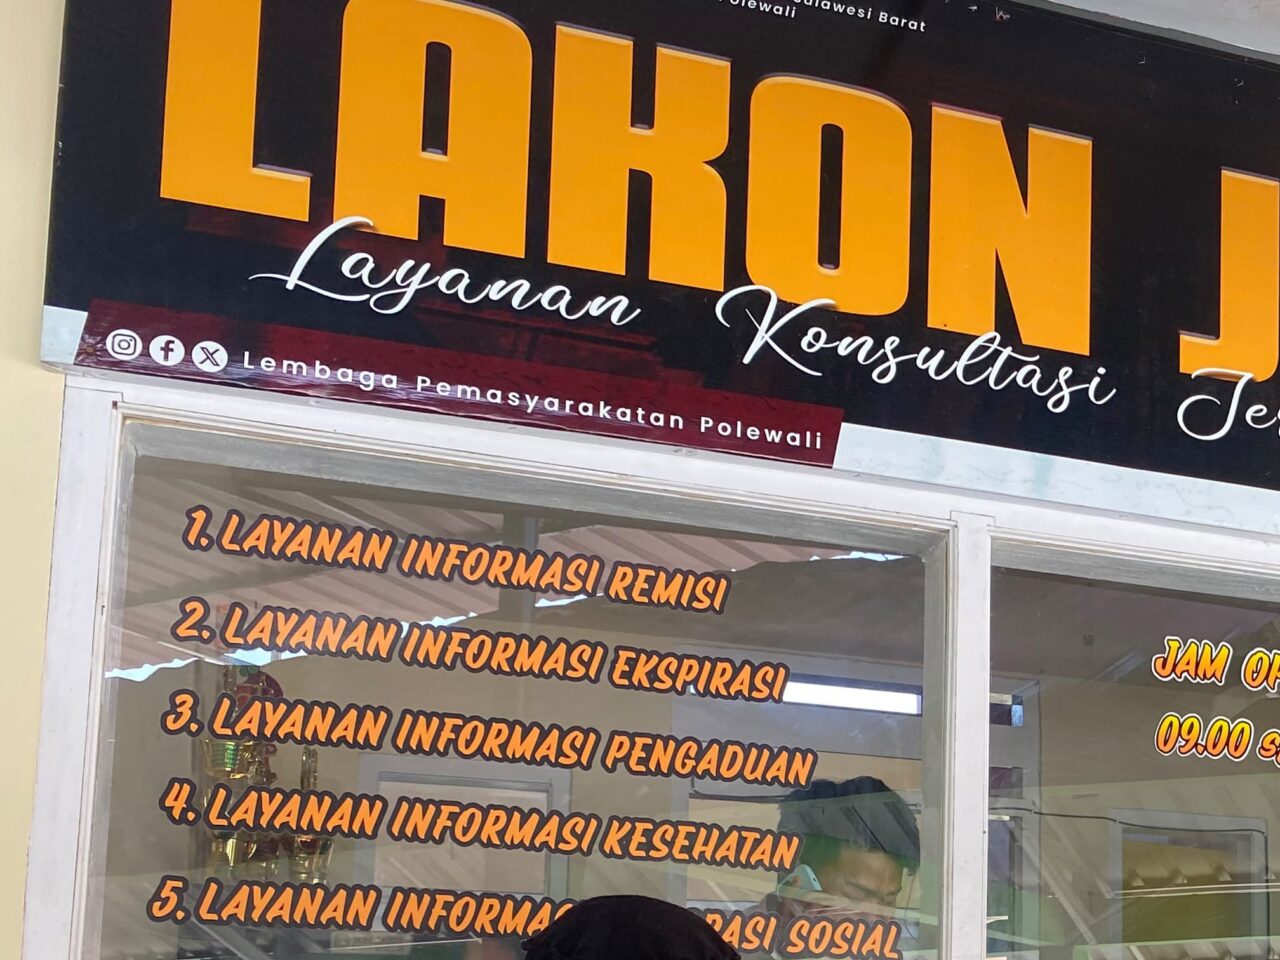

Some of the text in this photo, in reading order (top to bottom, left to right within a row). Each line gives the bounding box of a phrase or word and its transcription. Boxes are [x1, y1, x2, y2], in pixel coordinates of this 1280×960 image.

[717, 0, 797, 18] olewali
[793, 0, 927, 32] ulawesi Barat
[160, 0, 1093, 355] LAKON
[247, 215, 642, 327] Layanan
[714, 284, 1118, 414] Konsultasi
[242, 350, 822, 450] Lembaga Pemasyarakatan Polewali
[187, 509, 726, 610] 1. LAYANAN INFORMASI REMISI
[176, 600, 785, 699] 2. LAYANAN INFORMASI EKSPIRASI
[1153, 636, 1231, 685] JAM
[166, 693, 813, 785] 3. LAYANAN INFORMASI PENGADUAN
[1155, 712, 1254, 760] 09.00
[164, 782, 798, 867] 4. LAYANAN INFORMASI KESEHATAN
[152, 879, 185, 920] 5.
[199, 882, 376, 925] LAYANAN
[387, 892, 573, 936] INFORMA
[786, 919, 898, 960] SOSIAL
